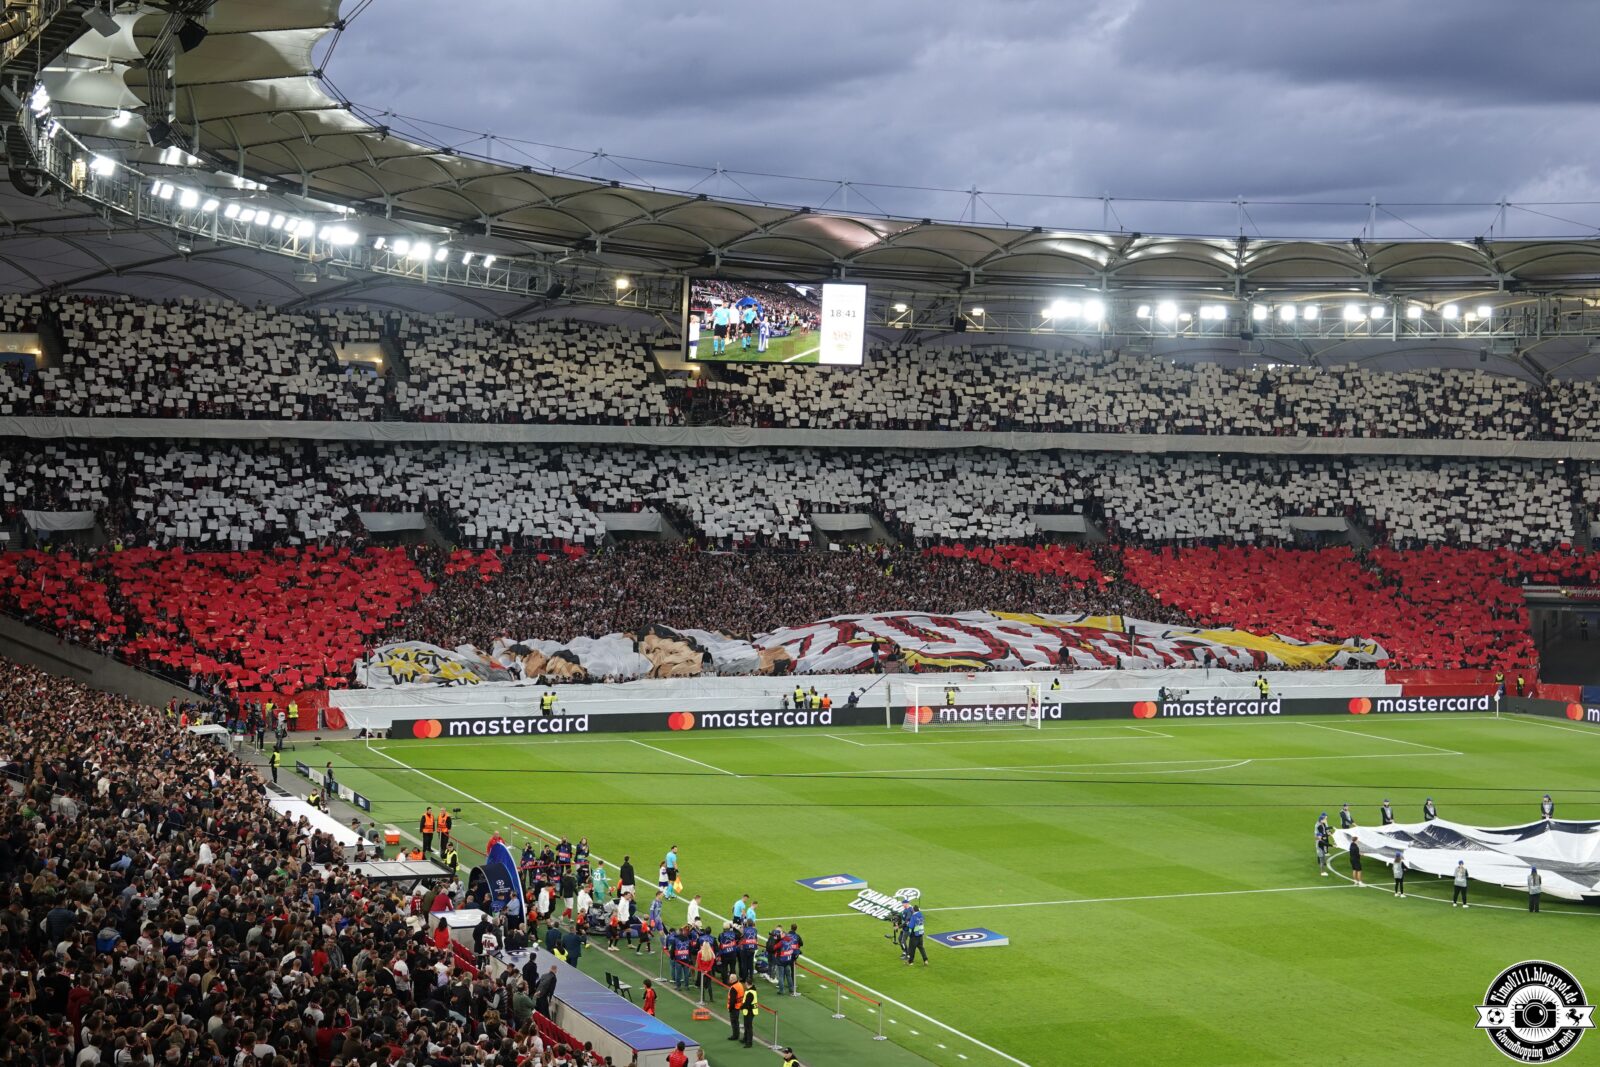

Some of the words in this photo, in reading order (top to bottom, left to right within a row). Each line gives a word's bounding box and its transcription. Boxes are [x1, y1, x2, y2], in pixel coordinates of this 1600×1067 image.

[940, 703, 1062, 721] mastercard
[1162, 699, 1281, 717] mastercard
[1377, 695, 1489, 712] mastercard
[449, 714, 589, 735] mastercard
[701, 708, 832, 727] mastercard
[857, 888, 905, 912] CHAMPIO
